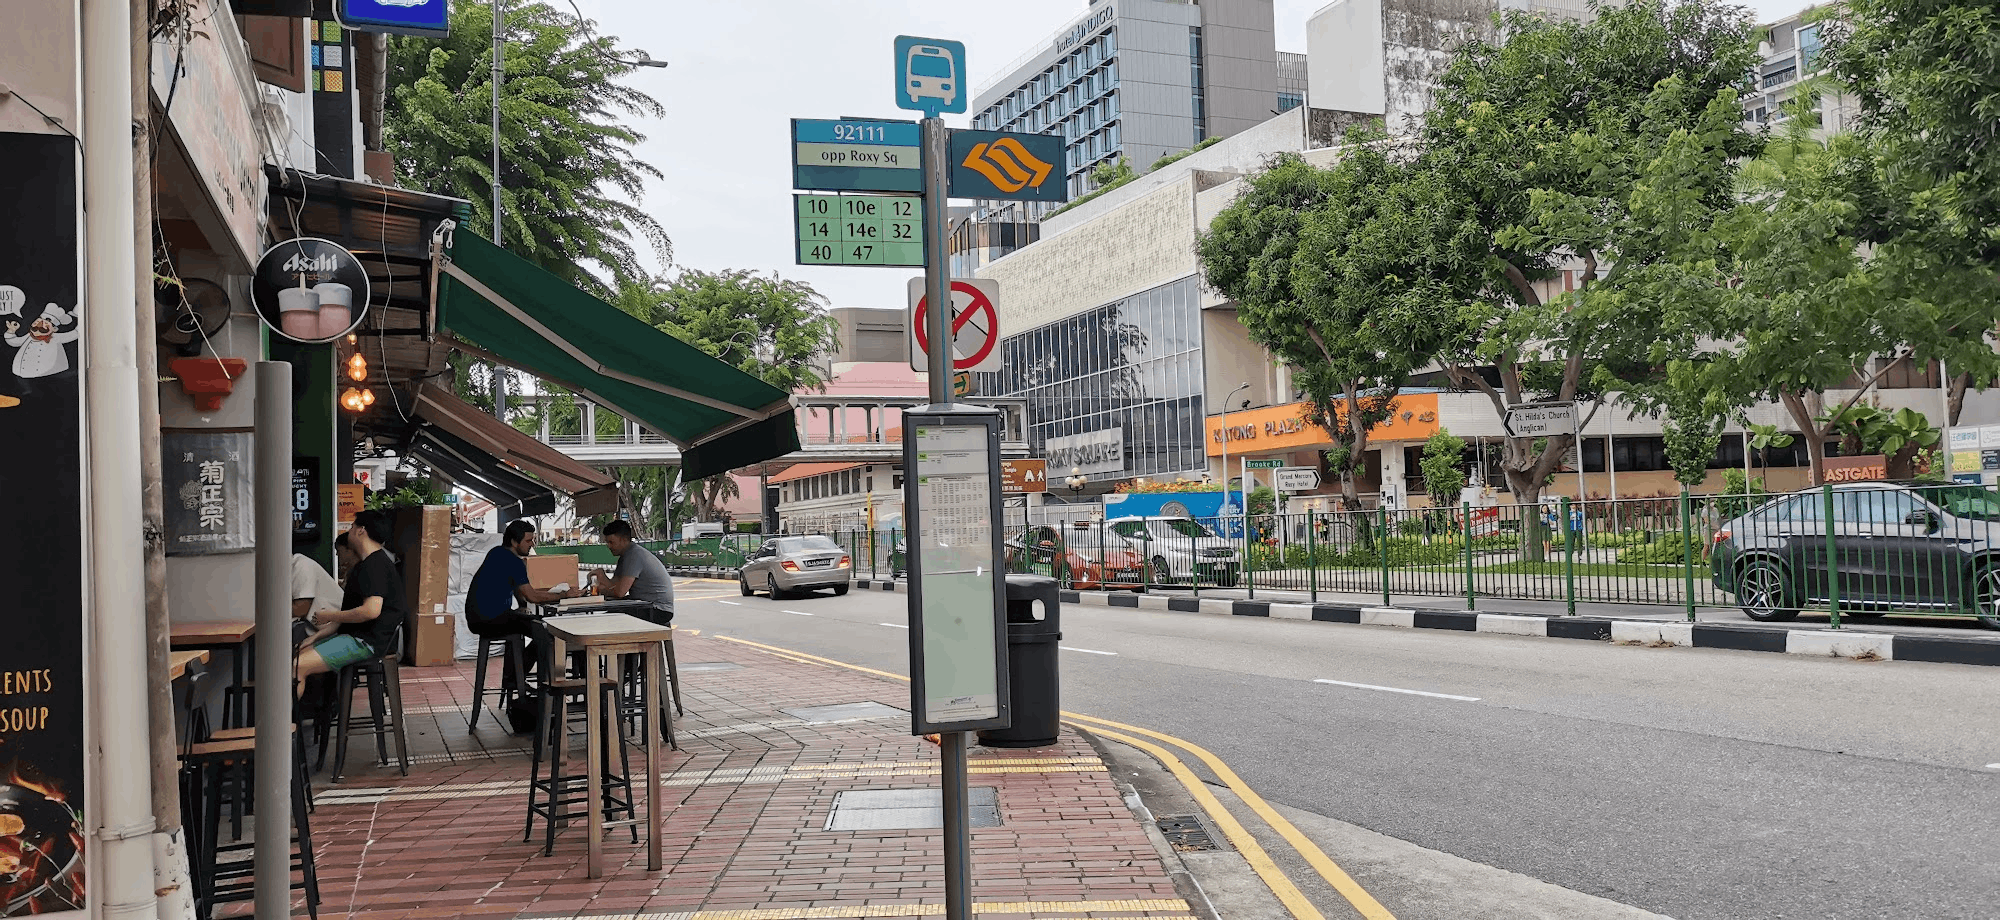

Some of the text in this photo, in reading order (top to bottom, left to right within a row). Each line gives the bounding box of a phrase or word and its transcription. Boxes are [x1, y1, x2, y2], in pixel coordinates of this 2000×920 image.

[834, 124, 885, 141] 92111
[821, 150, 898, 166] opp Roxy Sq
[808, 199, 912, 216] 10 10e 12
[809, 222, 912, 239] 14 14e 32
[810, 245, 873, 260] 40 47
[282, 252, 338, 272] Asahi
[1548, 410, 1570, 419] Church
[1073, 440, 1120, 466] SQUARE
[1822, 466, 1885, 481] ASTGATE
[199, 460, 225, 531] 菊正宗
[0, 669, 52, 694] ENTS
[0, 706, 49, 732] SOUP
